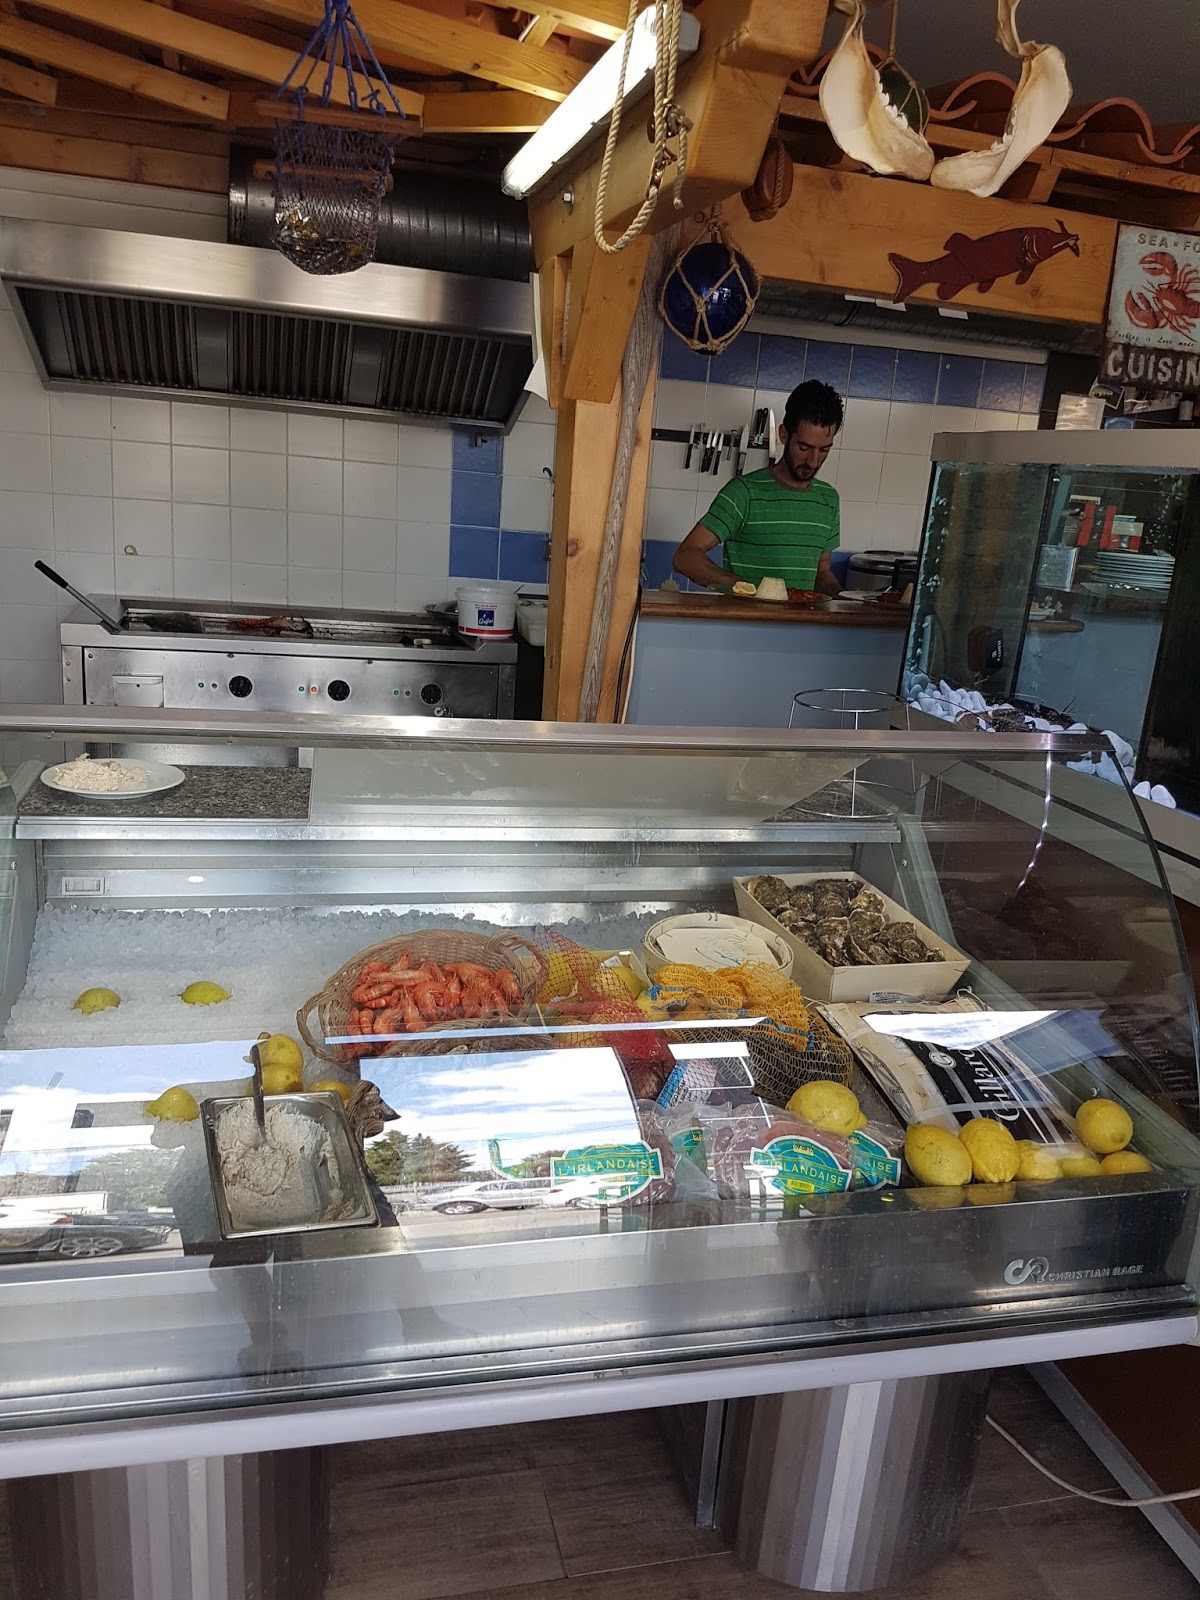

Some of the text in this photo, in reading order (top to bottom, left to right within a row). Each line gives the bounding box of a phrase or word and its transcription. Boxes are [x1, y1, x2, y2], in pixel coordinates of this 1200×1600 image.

[1137, 232, 1168, 249] SEA
[558, 1158, 656, 1176] L'IRLANDAISE
[1048, 1267, 1111, 1282] CHRISTIAN
